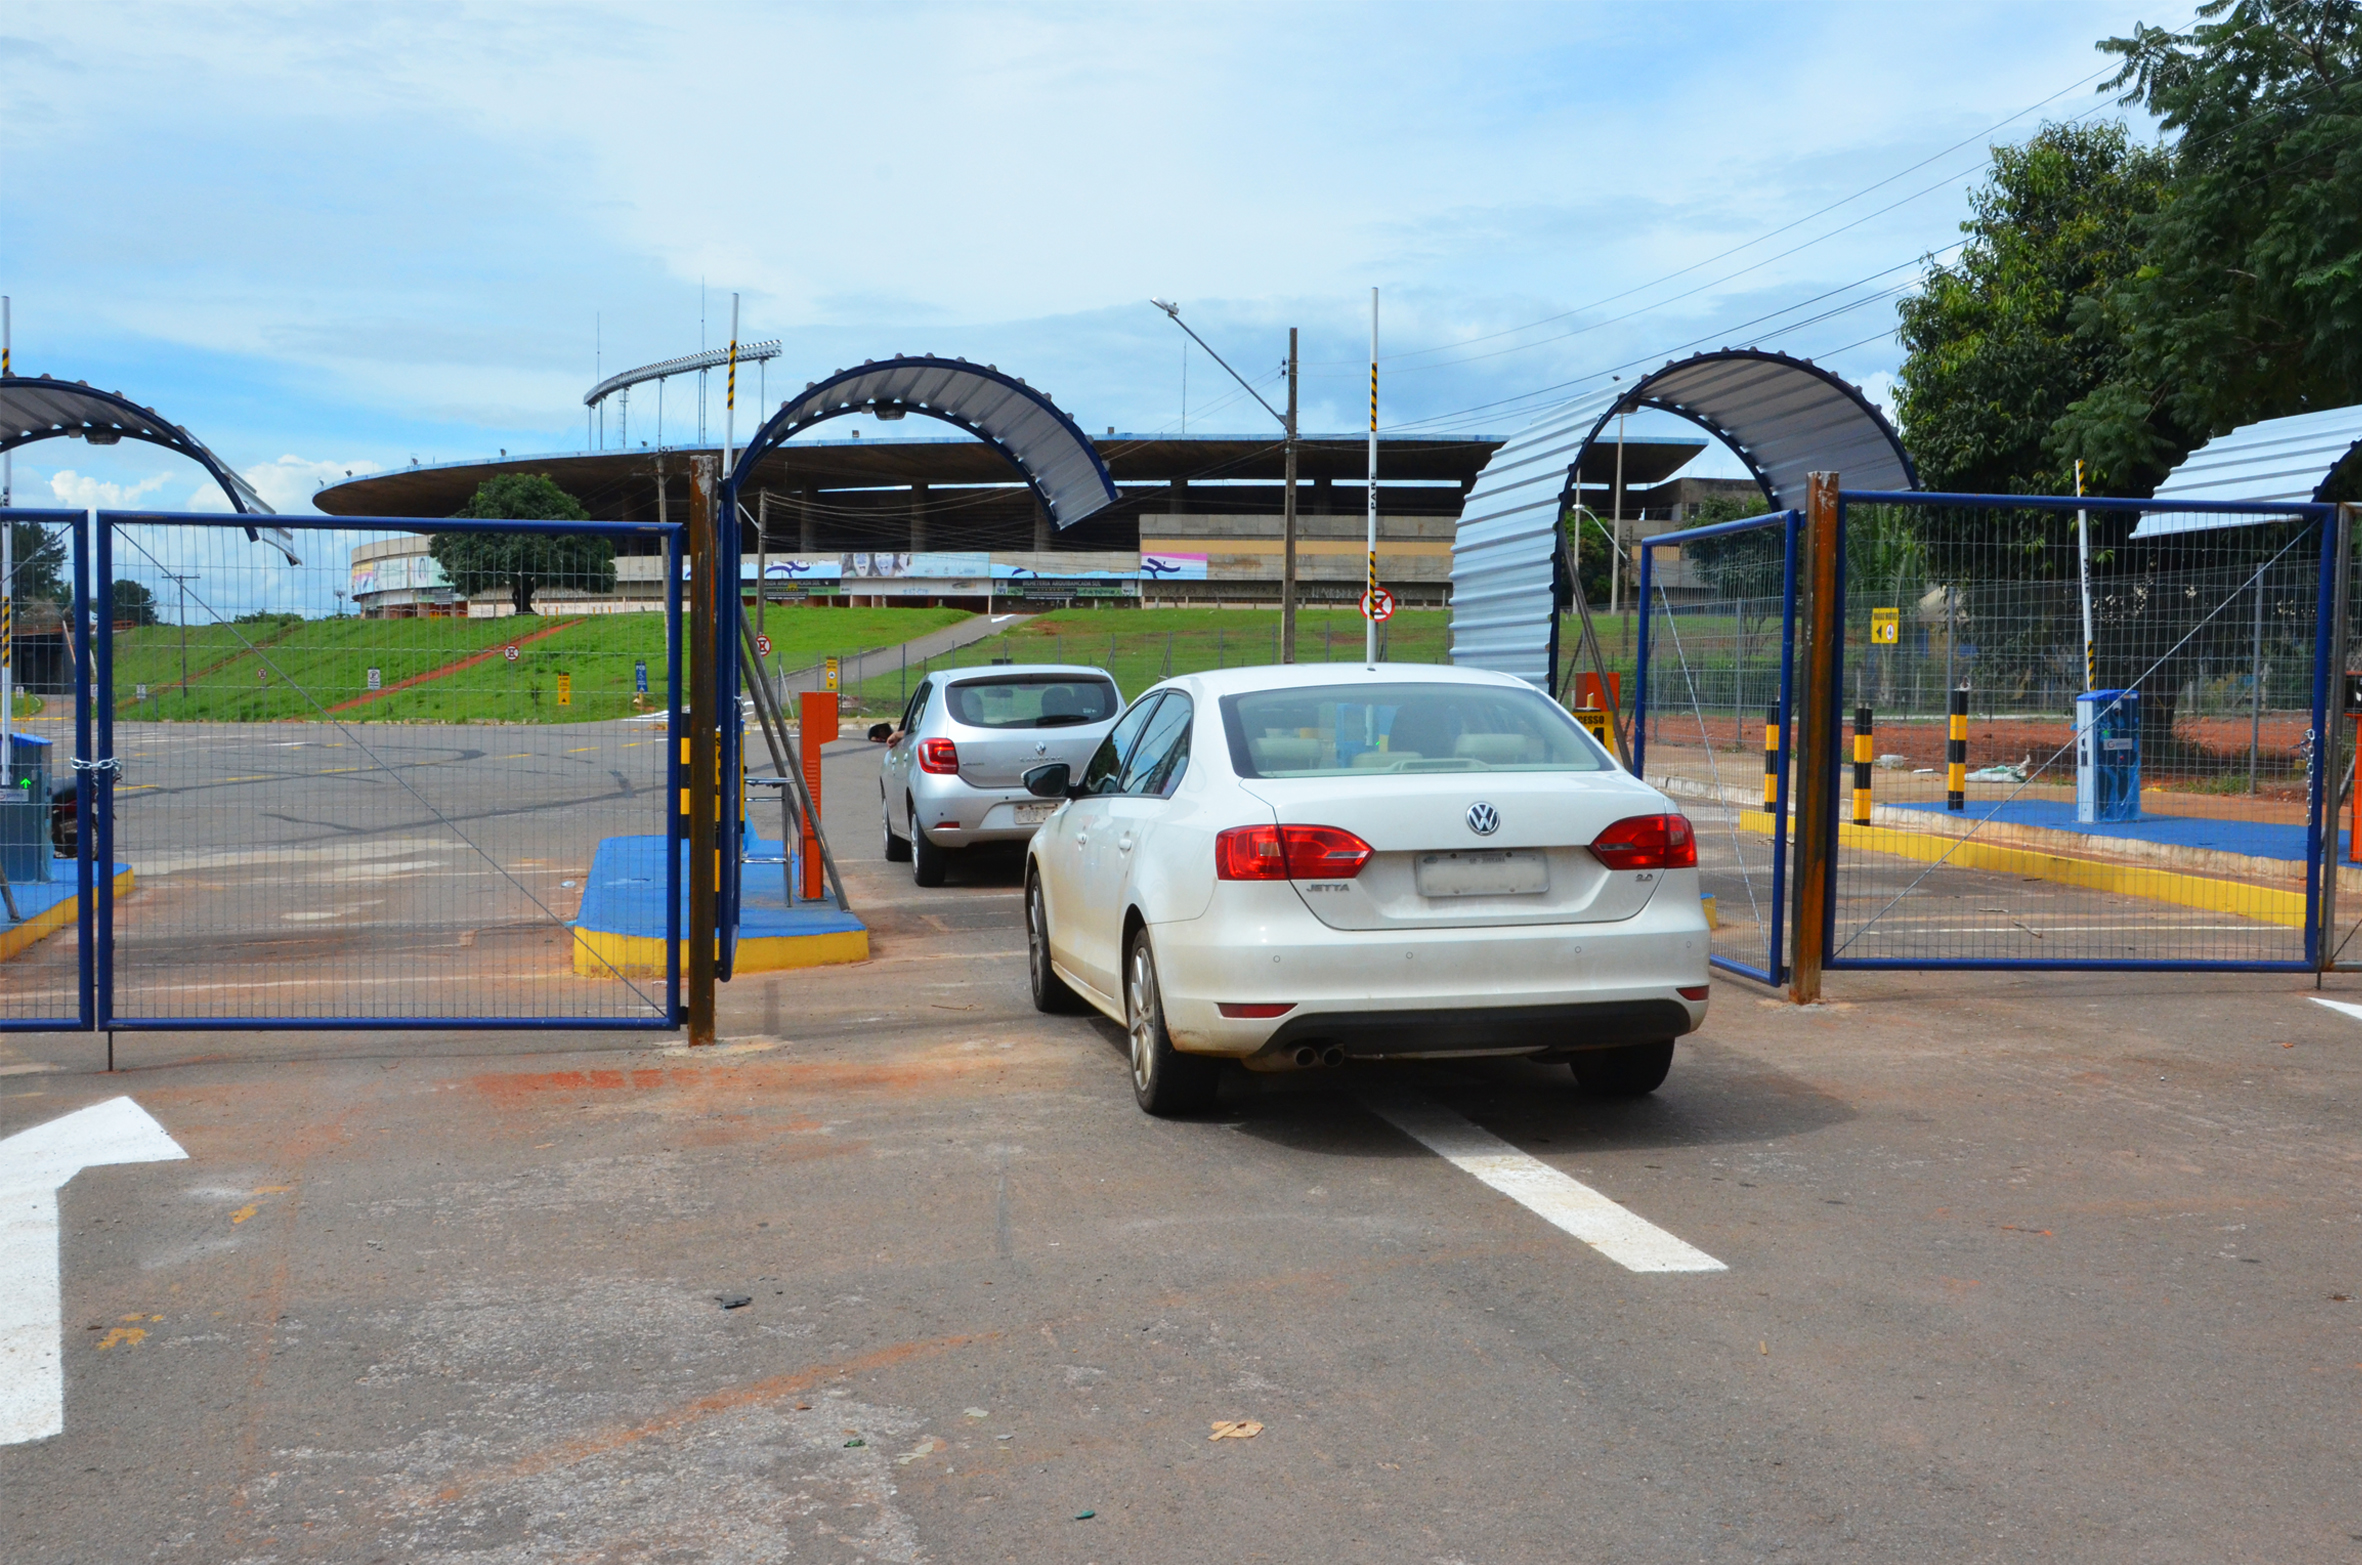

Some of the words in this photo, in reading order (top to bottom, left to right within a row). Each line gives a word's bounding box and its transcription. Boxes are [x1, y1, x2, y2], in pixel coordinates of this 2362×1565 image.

[1575, 715, 1605, 725] CESSO
[1635, 873, 1653, 882] 2.0
[1306, 883, 1350, 892] JETTA
